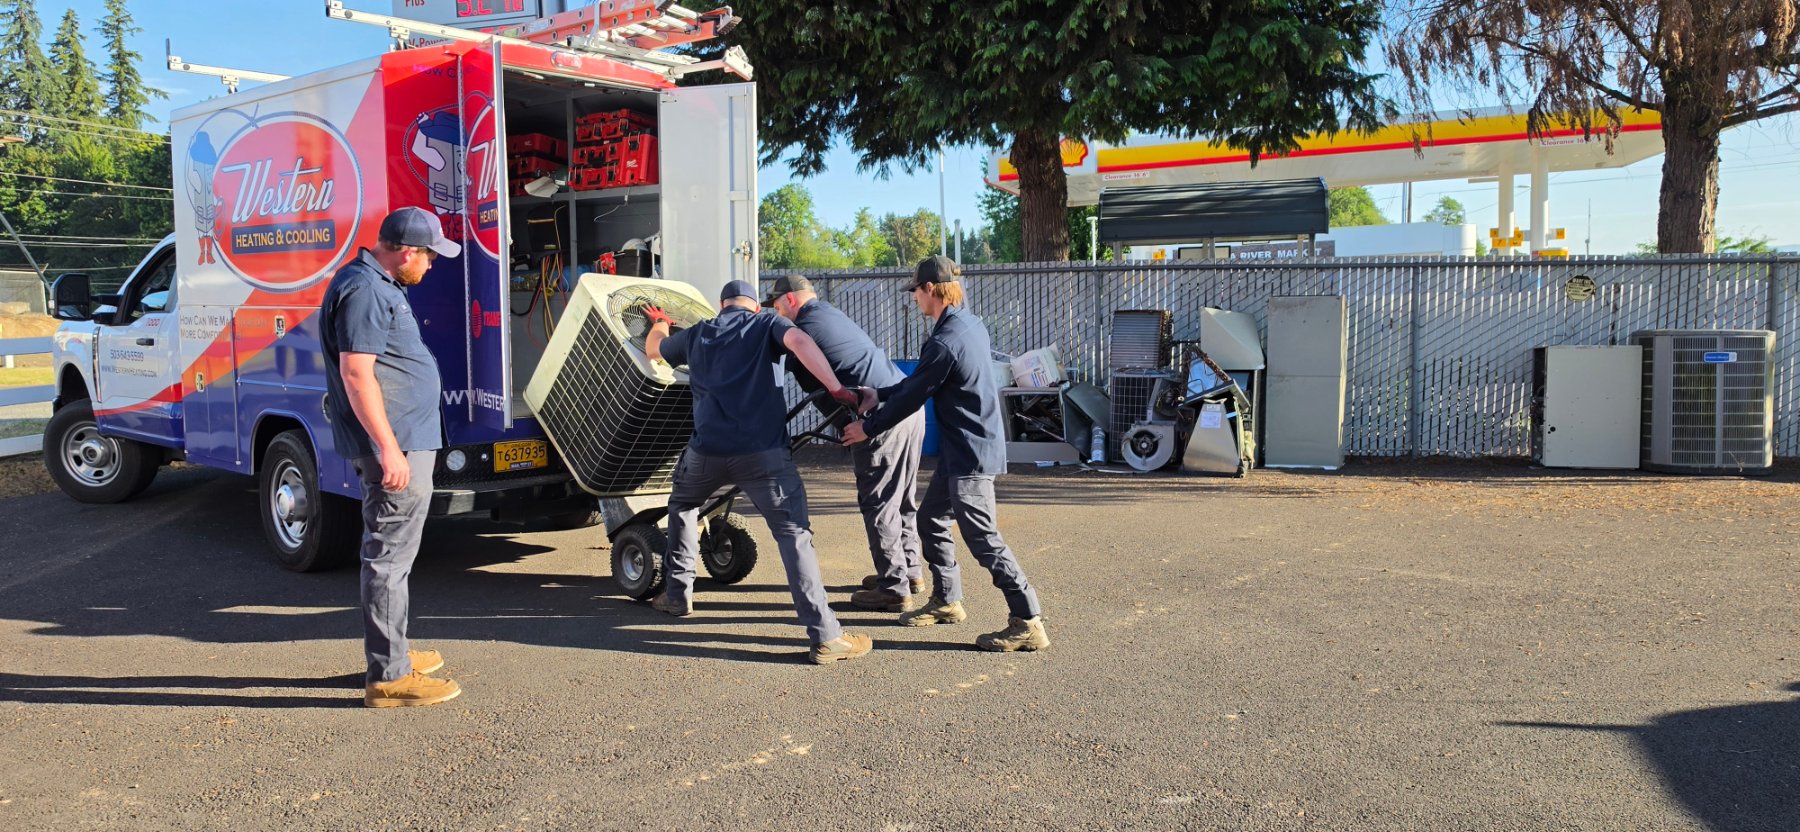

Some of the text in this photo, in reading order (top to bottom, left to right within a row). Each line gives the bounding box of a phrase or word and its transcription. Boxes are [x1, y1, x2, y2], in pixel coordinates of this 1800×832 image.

[221, 157, 335, 224] Western
[235, 228, 330, 248] HEATING & COOLING
[1240, 250, 1272, 260] RIVER
[1277, 247, 1322, 258] MARKT
[194, 315, 207, 326] CAN
[208, 315, 219, 327] WE
[180, 328, 197, 340] MORE
[497, 446, 545, 462] T637935
